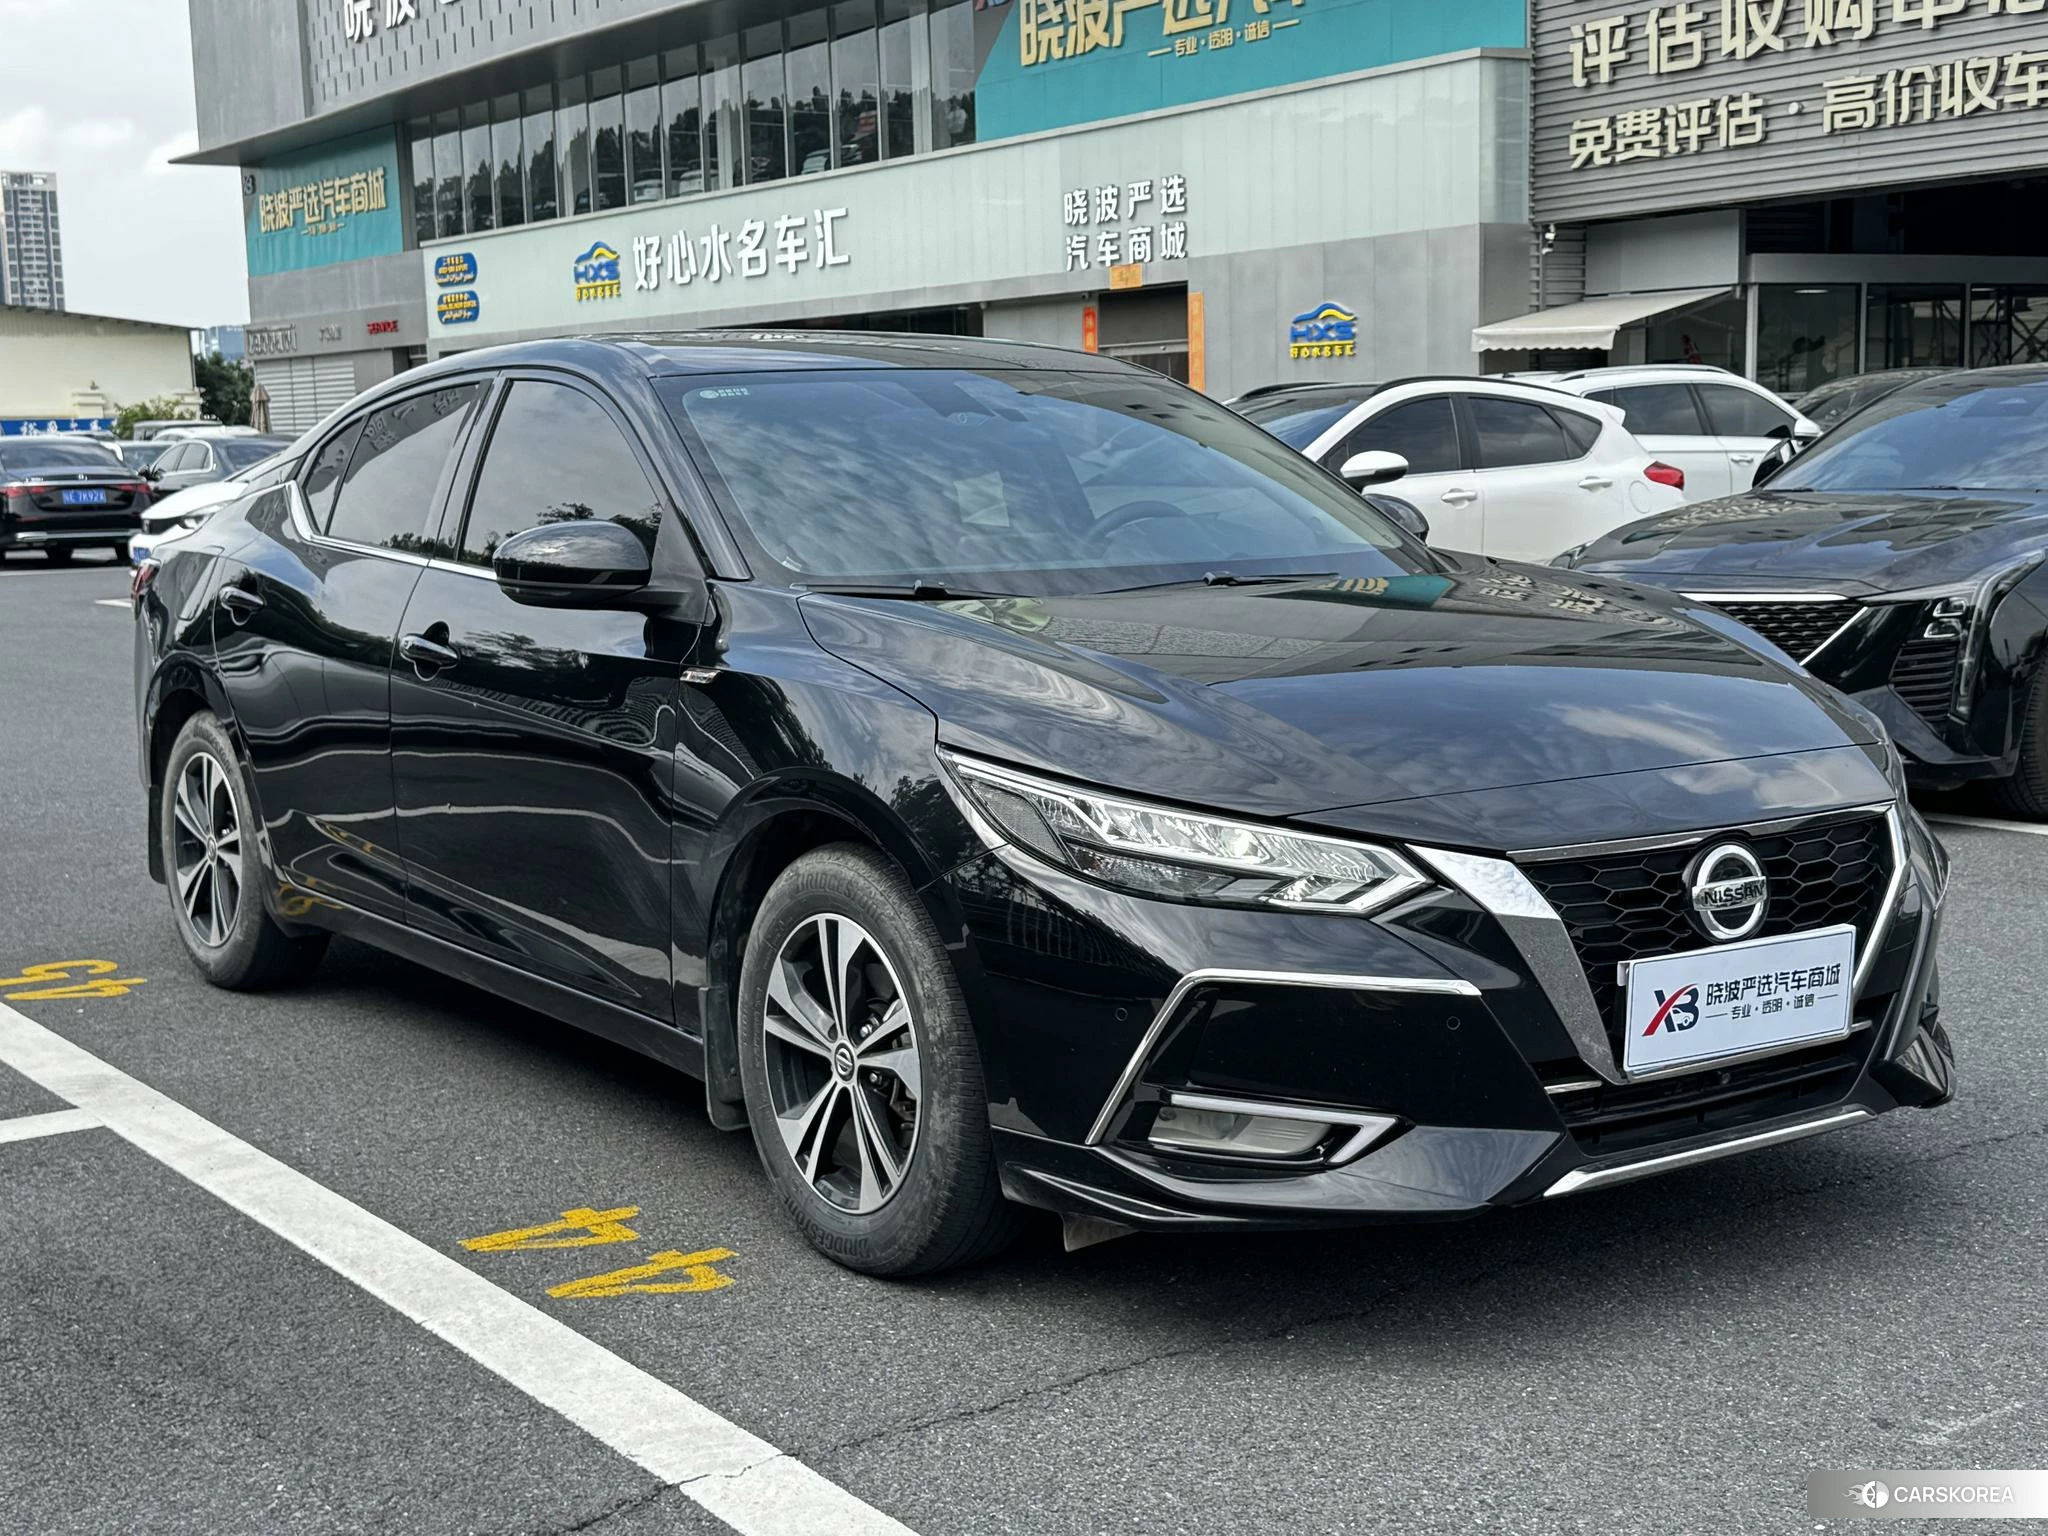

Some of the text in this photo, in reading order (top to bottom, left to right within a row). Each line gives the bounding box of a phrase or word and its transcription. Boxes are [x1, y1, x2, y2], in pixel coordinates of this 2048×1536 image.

[259, 166, 387, 232] 晓波严选汽车商城
[1063, 174, 1186, 225] 晓波严选
[633, 207, 850, 290] 好心水名车汇
[1065, 221, 1187, 271] 汽车商城
[1290, 321, 1355, 342] HXS
[1703, 881, 1766, 905] NISSAN
[1706, 963, 1841, 1006] 晓波严选汽车商城
